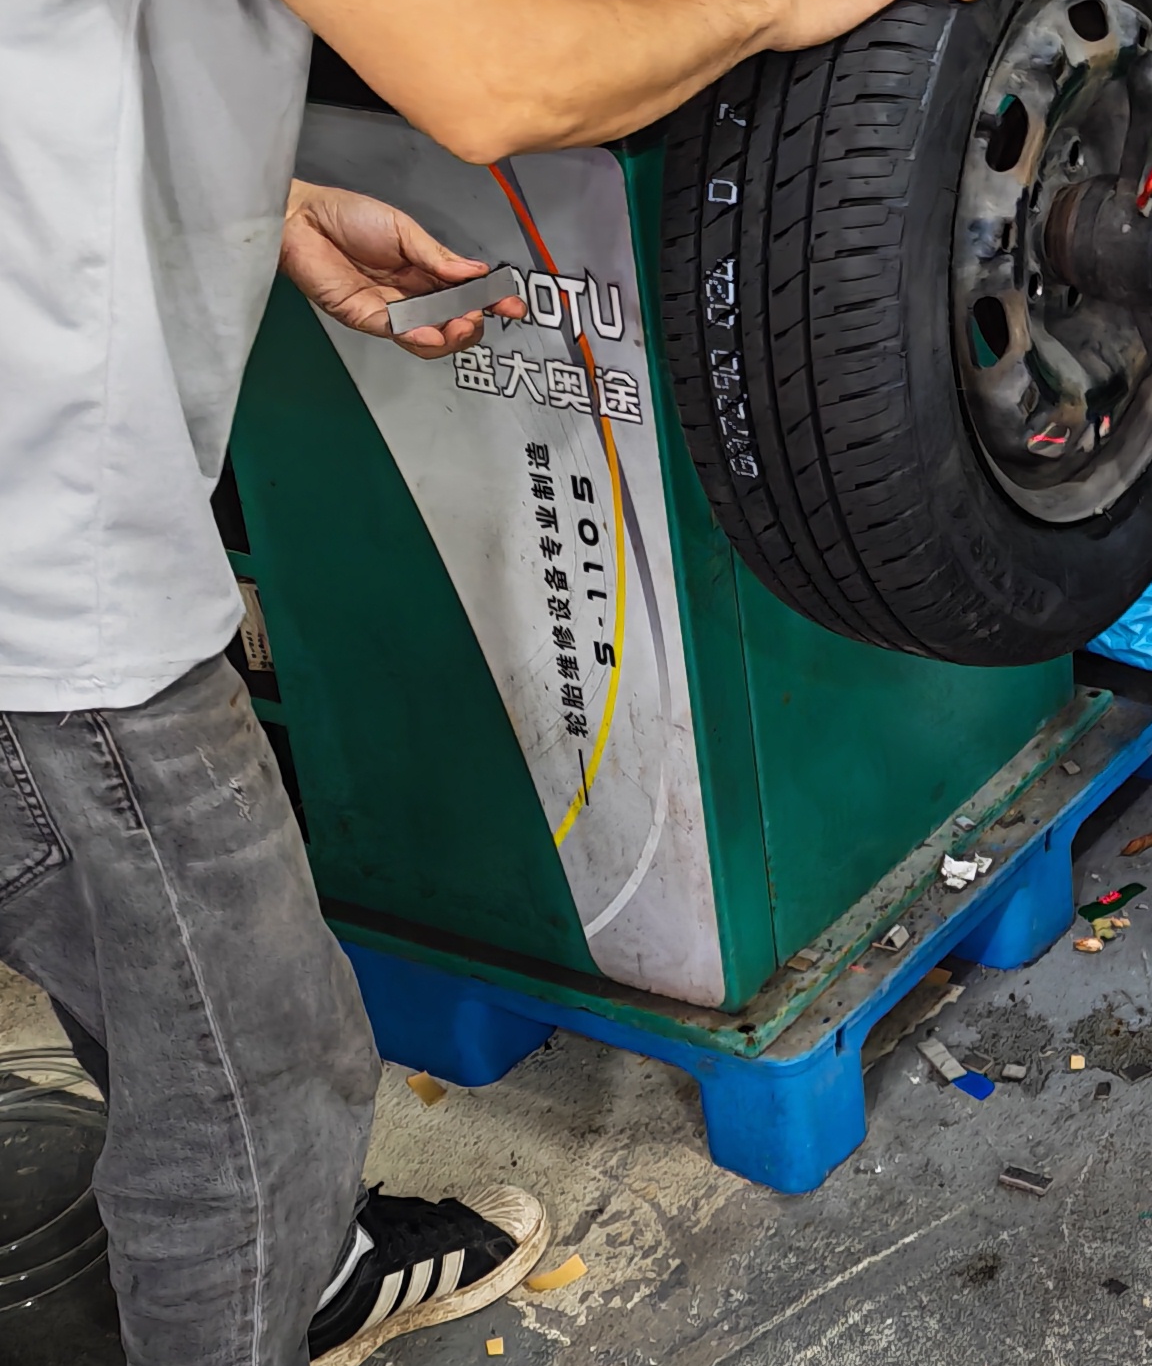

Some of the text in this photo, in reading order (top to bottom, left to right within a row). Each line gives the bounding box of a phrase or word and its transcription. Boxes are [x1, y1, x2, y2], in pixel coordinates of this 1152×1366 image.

[453, 343, 643, 425] 盛大奥途
[524, 442, 588, 739] 轮胎维修设备专业制造
